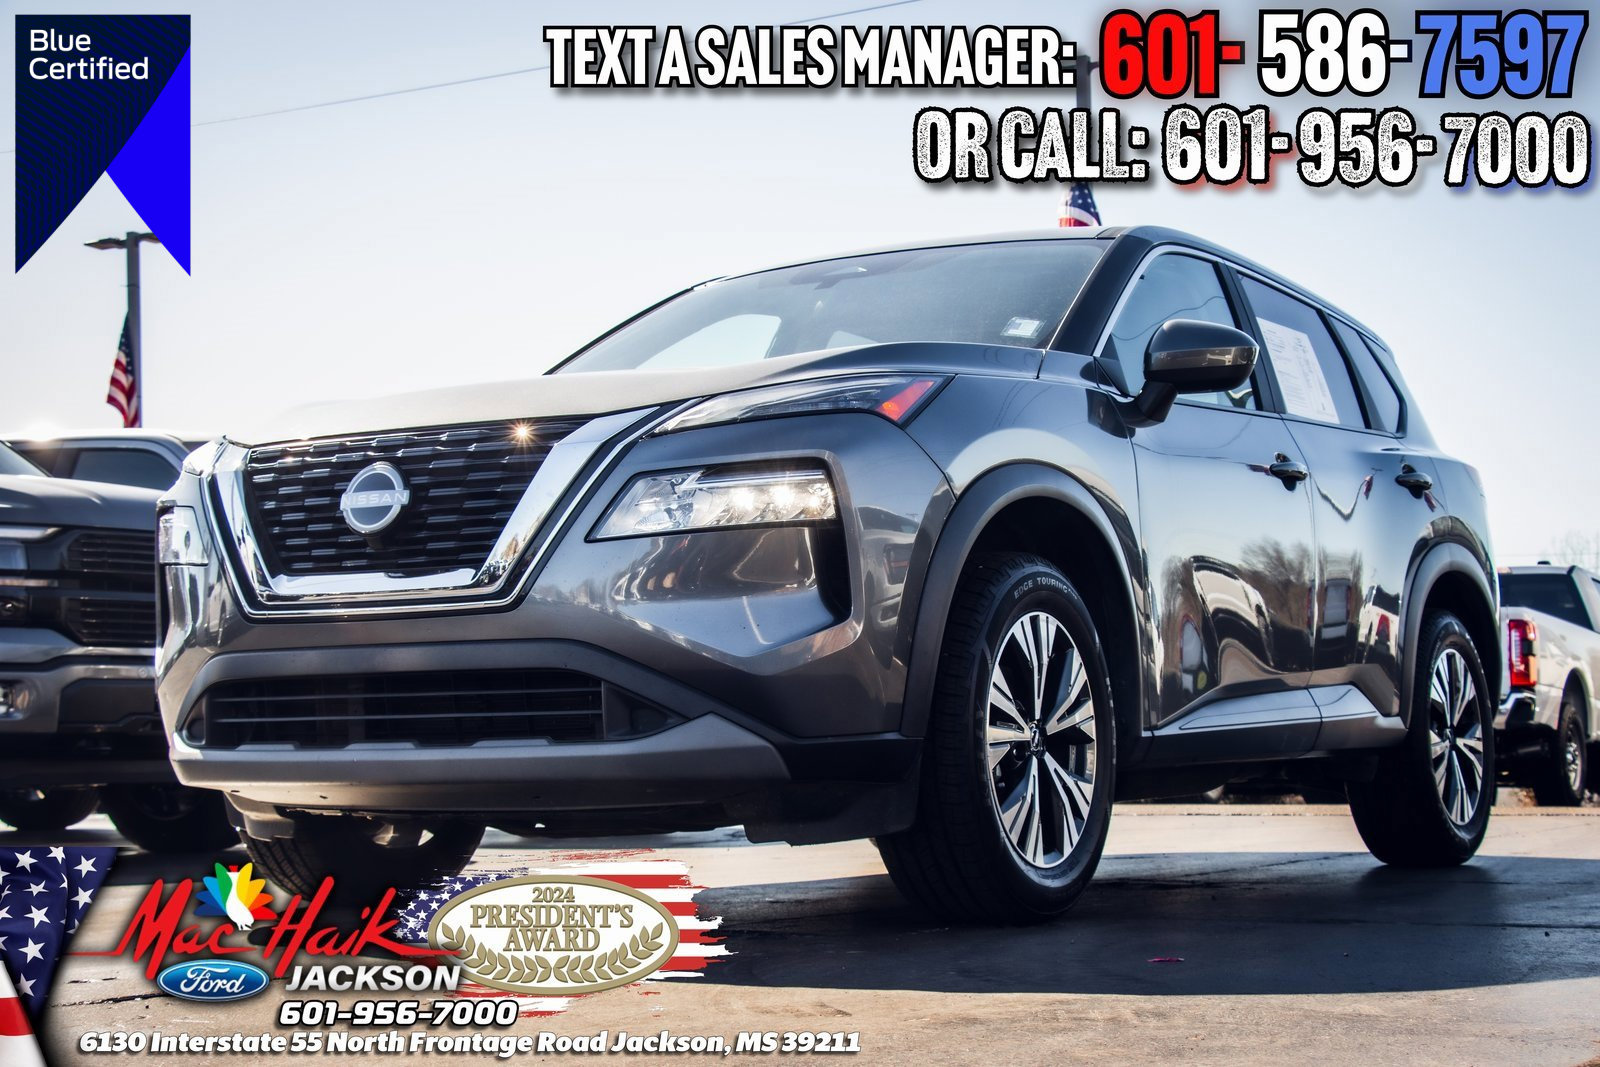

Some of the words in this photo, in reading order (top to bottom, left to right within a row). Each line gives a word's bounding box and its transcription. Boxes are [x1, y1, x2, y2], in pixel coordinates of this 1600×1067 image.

[343, 492, 407, 507] NISSAN
[1014, 579, 1033, 599] EDGE
[1036, 577, 1068, 593] TOURING
